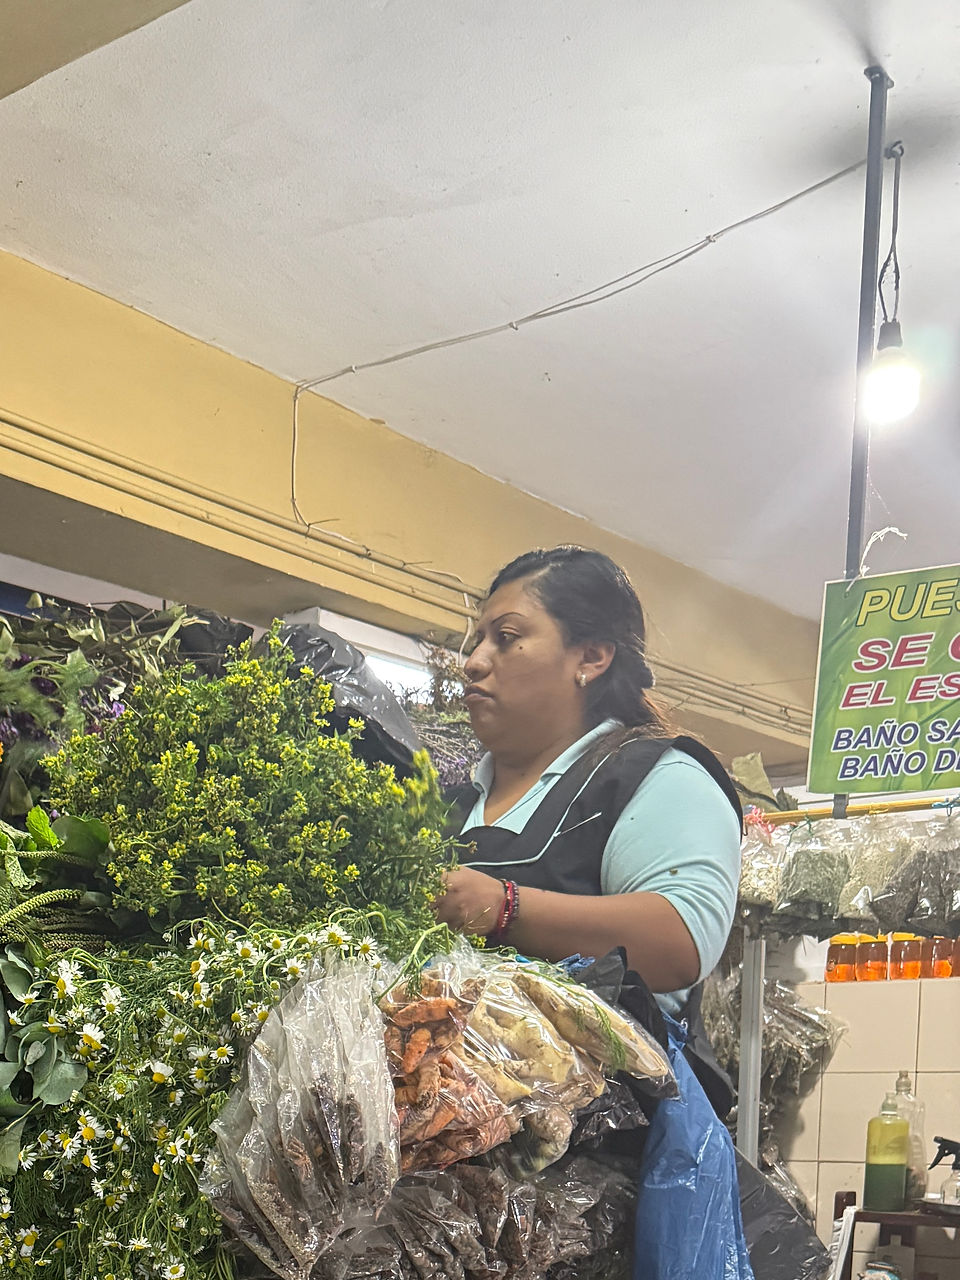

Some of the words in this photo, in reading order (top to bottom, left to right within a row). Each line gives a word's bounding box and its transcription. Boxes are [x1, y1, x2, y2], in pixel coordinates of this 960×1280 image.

[856, 578, 960, 627] PUE
[852, 632, 936, 673] SE
[839, 680, 896, 709] EL
[832, 719, 919, 751] BAÑO
[839, 748, 926, 779] BAÑO
